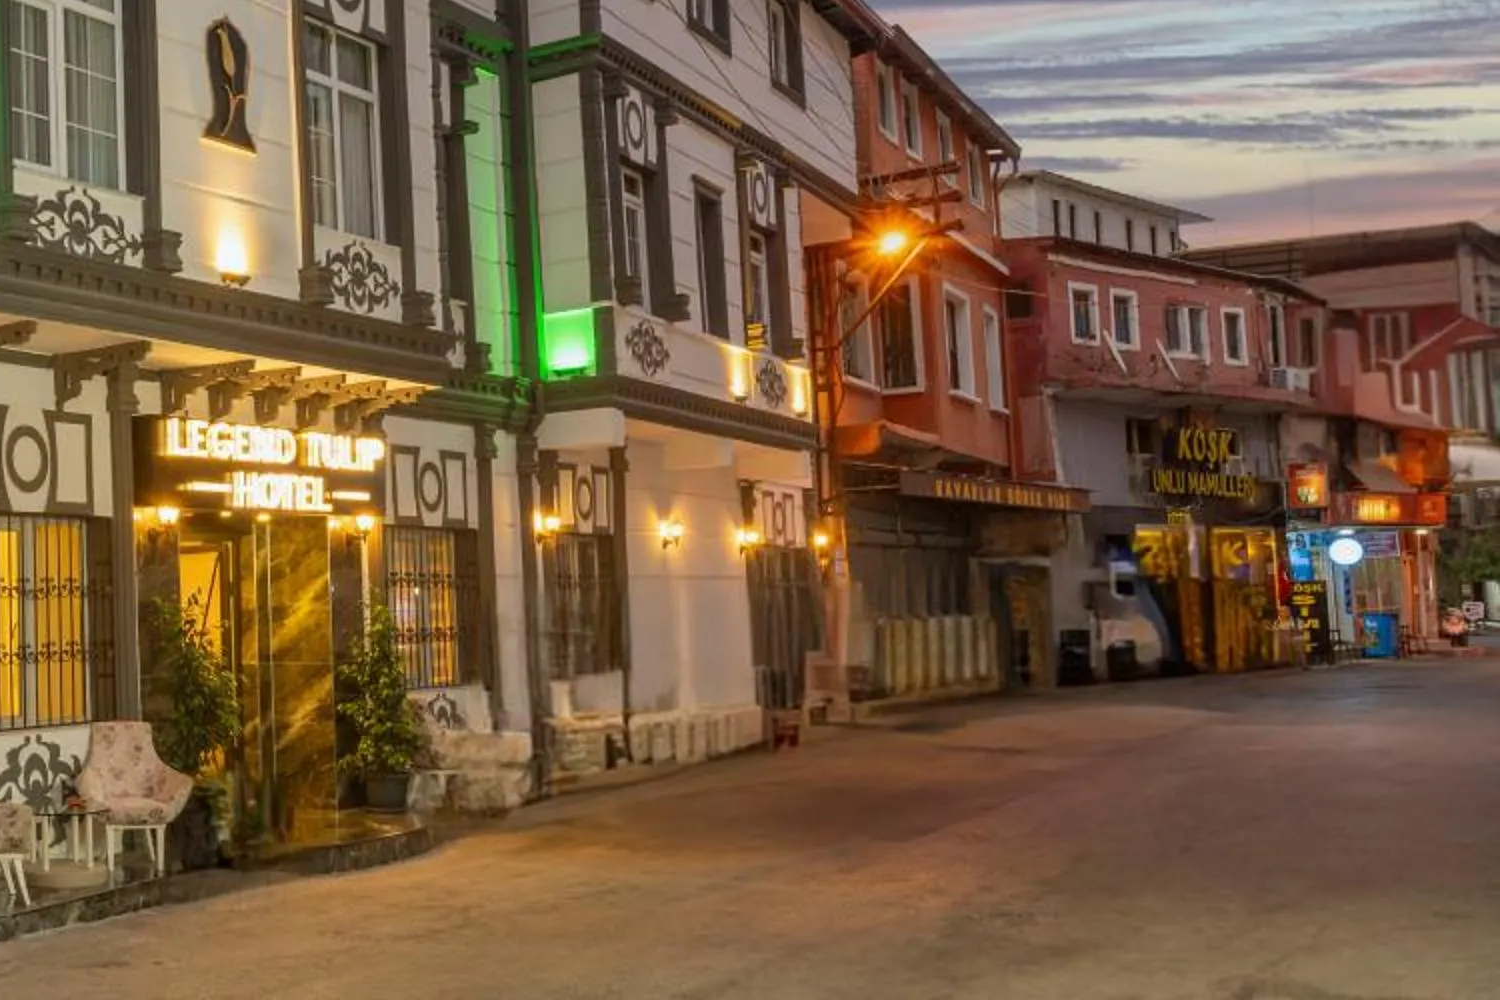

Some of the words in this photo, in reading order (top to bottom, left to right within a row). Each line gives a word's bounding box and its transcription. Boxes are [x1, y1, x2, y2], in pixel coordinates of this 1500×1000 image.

[163, 416, 297, 465] LEGEND
[300, 431, 385, 471] TULIP
[229, 471, 333, 513] HOTEL
